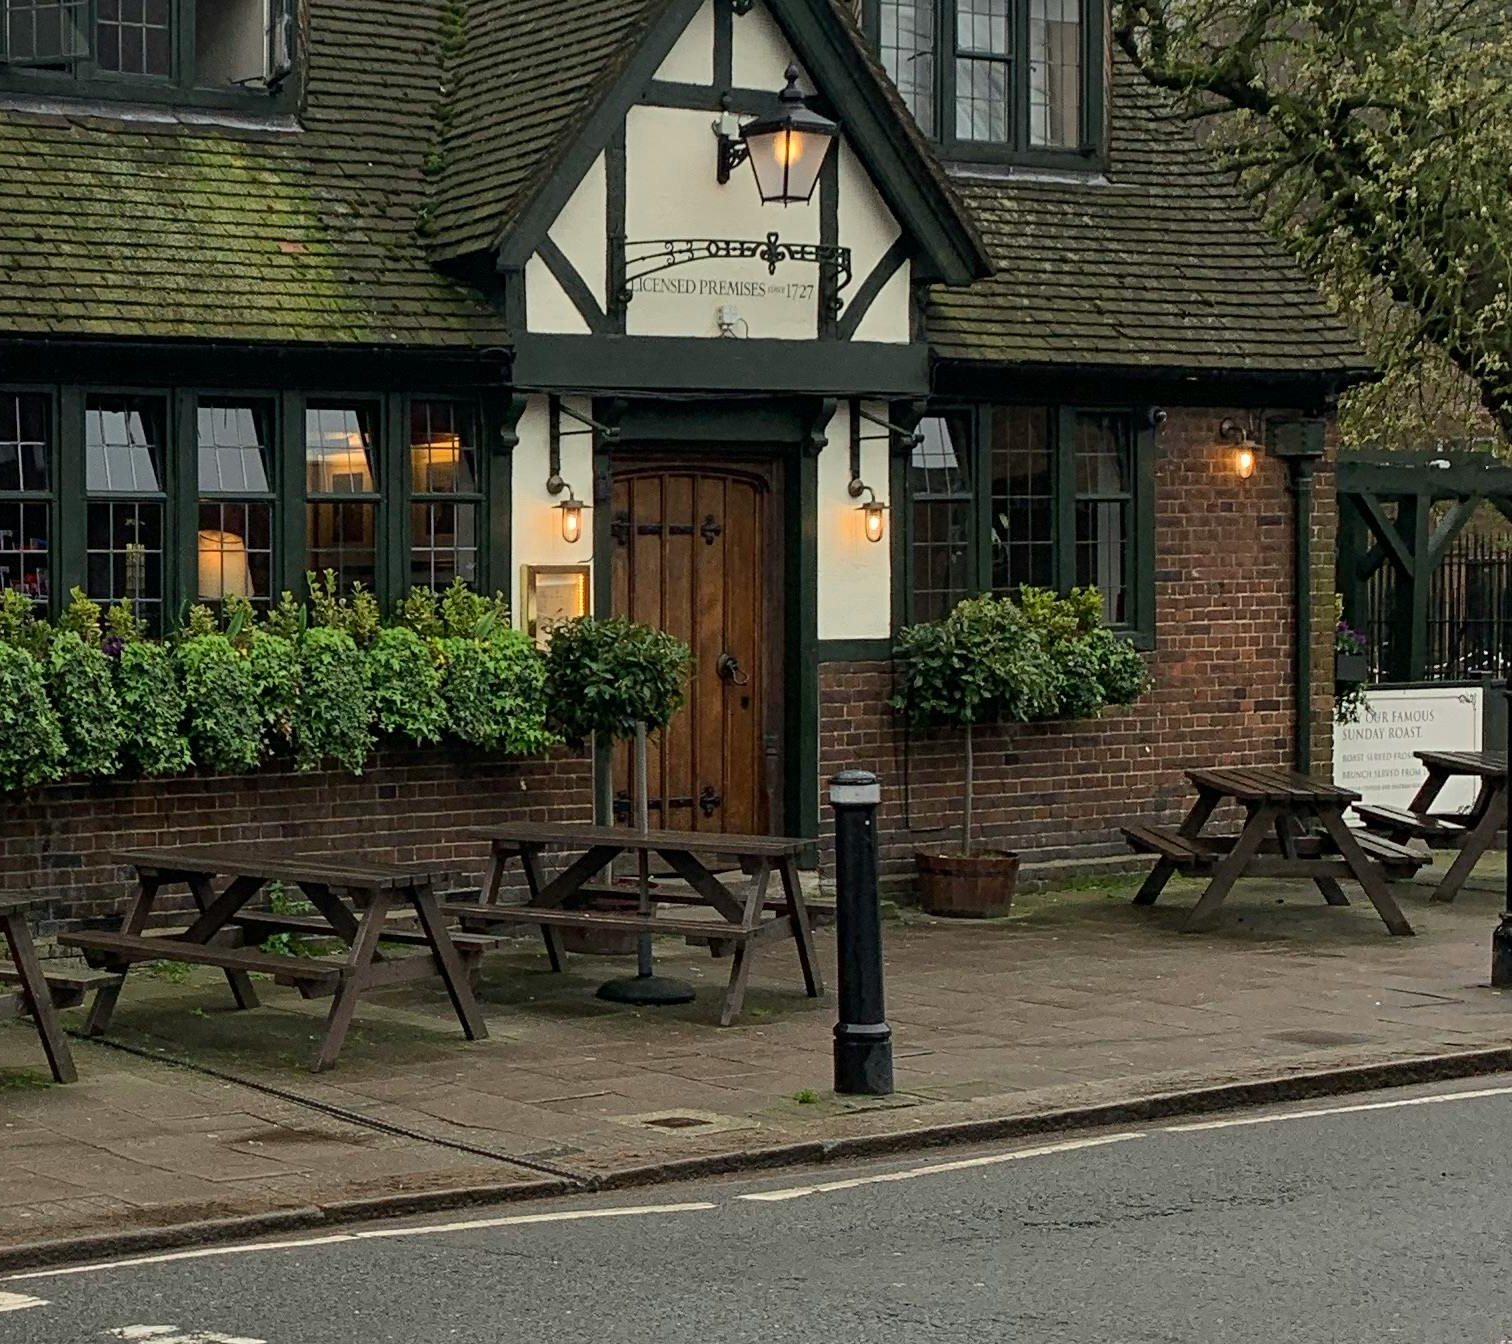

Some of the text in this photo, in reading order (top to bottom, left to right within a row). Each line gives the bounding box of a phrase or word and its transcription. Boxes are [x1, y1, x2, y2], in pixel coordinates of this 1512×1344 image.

[631, 277, 696, 295] LICENSED
[699, 279, 766, 297] PREMISES
[786, 283, 814, 301] 1727
[1392, 709, 1435, 723] FAMOUS
[1342, 727, 1385, 741] SUNDAY
